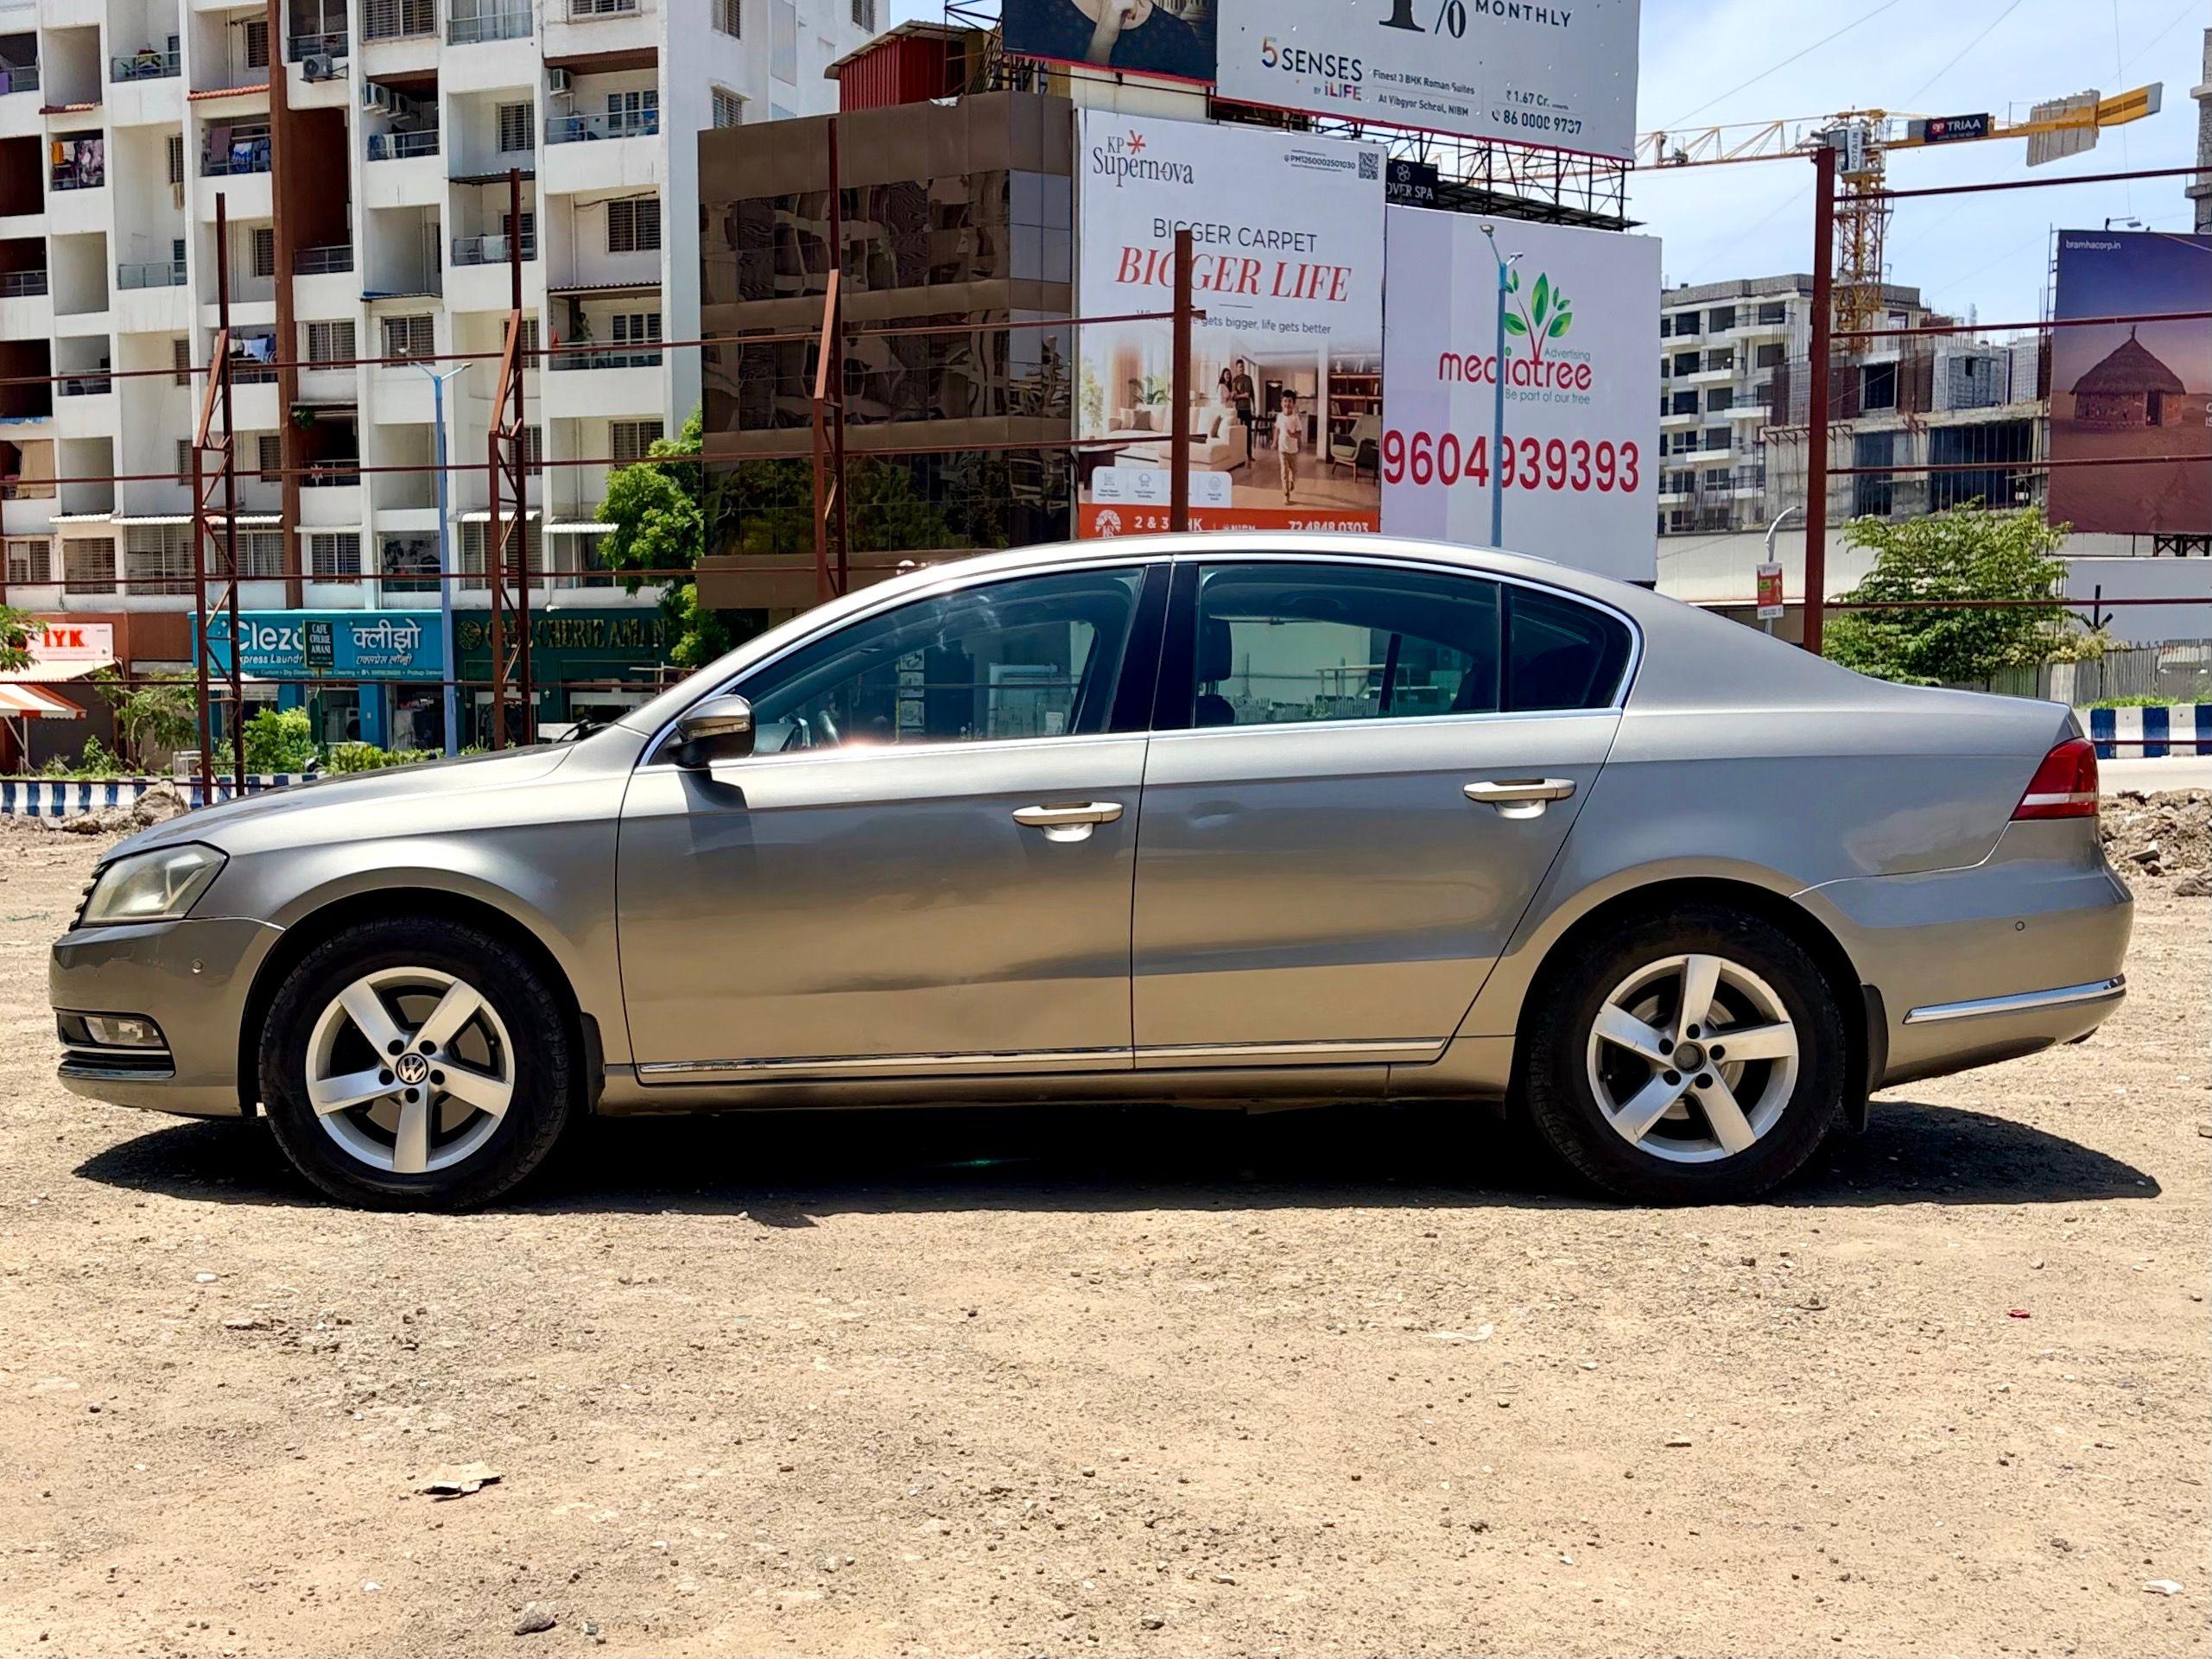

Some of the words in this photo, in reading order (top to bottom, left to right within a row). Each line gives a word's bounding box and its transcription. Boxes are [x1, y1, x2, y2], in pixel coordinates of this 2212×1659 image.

[1475, 0, 1572, 27] MONTHLY
[1262, 36, 1277, 68] 5
[1281, 47, 1363, 82] SENSES
[1372, 69, 1397, 82] Finest
[1398, 73, 1404, 84] 3
[1405, 74, 1423, 86] BHK
[1947, 118, 1981, 132] TRIAA
[1106, 136, 1125, 155] KP
[1093, 146, 1195, 187] Supernova
[1414, 185, 1434, 200] SPA
[1238, 227, 1317, 253] CARPET
[1271, 262, 1352, 302] LIFE
[1261, 319, 1277, 331] life
[1278, 322, 1300, 333] gets
[1302, 323, 1331, 335] better
[1543, 347, 1590, 363] Advertising
[1505, 389, 1517, 401] Be
[1519, 390, 1540, 402] part
[1543, 390, 1552, 402] of
[1554, 393, 1570, 403] our
[1571, 393, 1591, 405] tree
[1384, 429, 1639, 493] 9604939393
[1133, 516, 1143, 529] 2
[1146, 516, 1157, 529] &
[239, 655, 269, 666] xpress
[270, 654, 303, 664] Laundr
